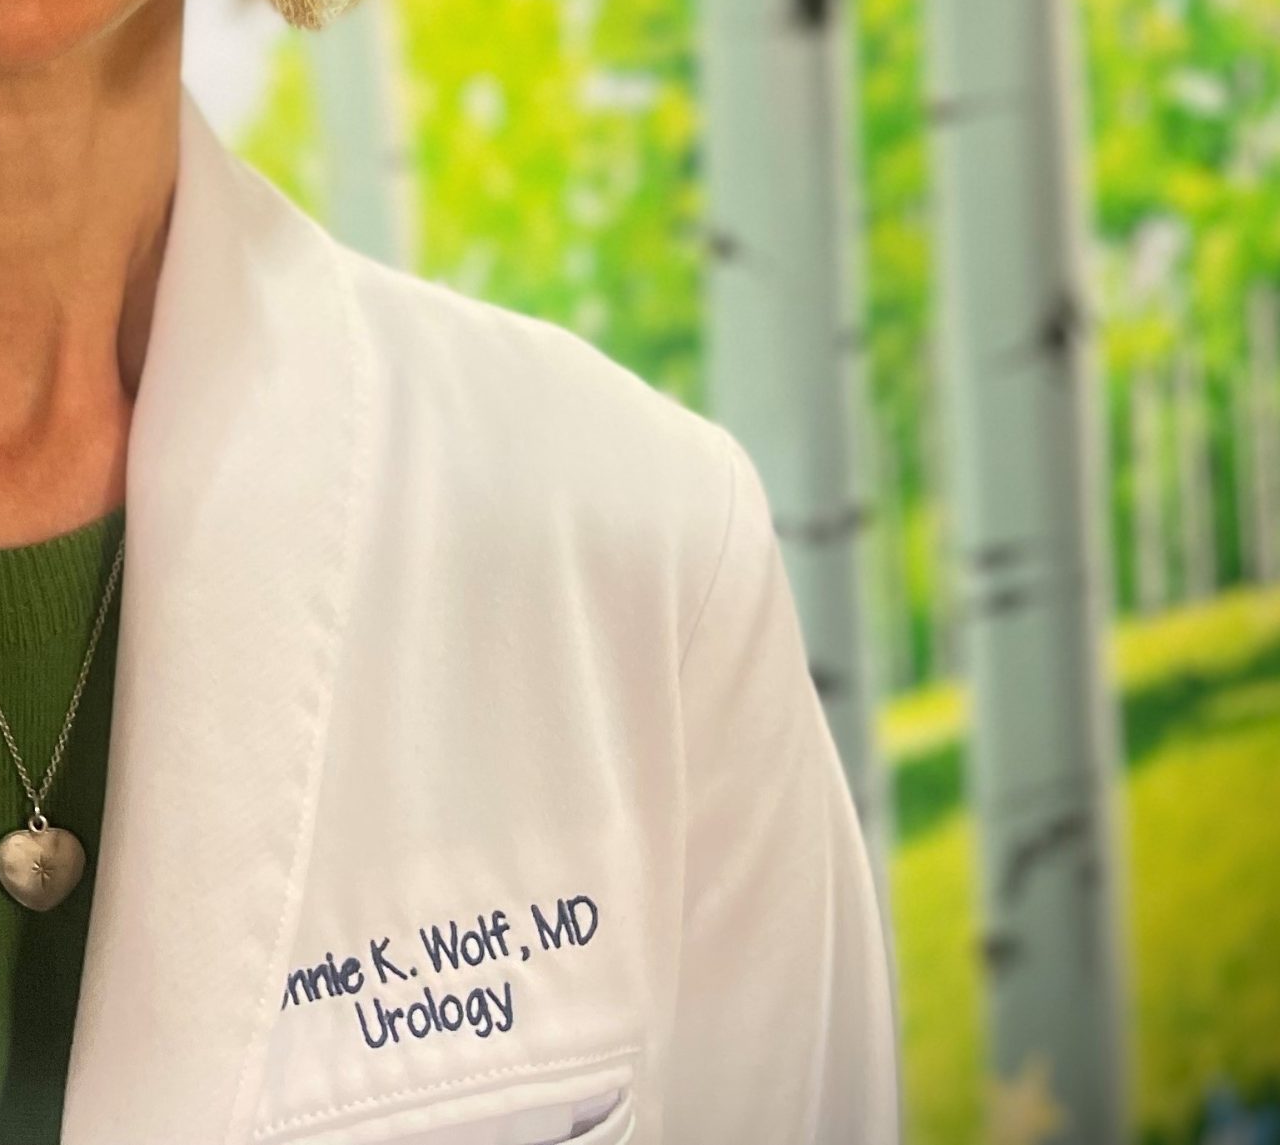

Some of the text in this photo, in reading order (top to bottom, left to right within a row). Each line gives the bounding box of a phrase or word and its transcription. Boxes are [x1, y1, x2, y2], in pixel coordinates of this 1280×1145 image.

[281, 895, 599, 1011] nnie K. Wolf, MD
[354, 982, 514, 1049] Urology
